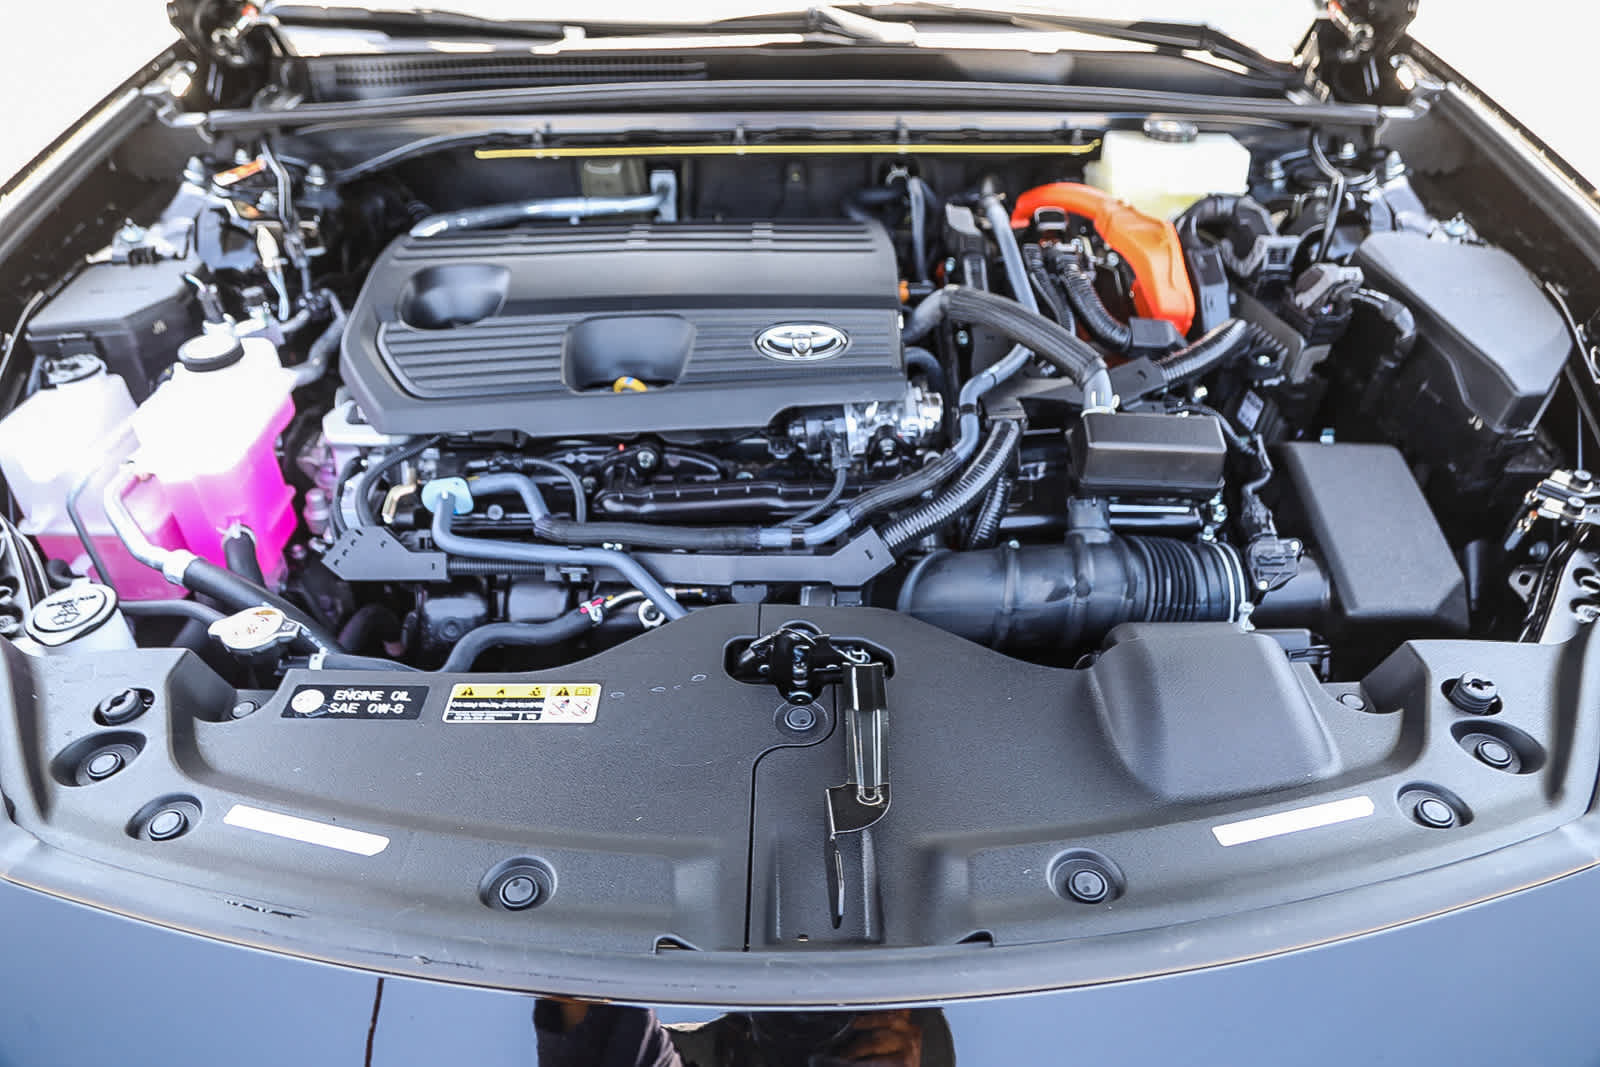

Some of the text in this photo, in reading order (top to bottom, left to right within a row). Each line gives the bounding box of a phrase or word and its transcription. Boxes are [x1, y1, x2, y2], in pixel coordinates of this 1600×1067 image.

[333, 689, 412, 702] ENGINE OIL
[328, 703, 360, 714] SAE
